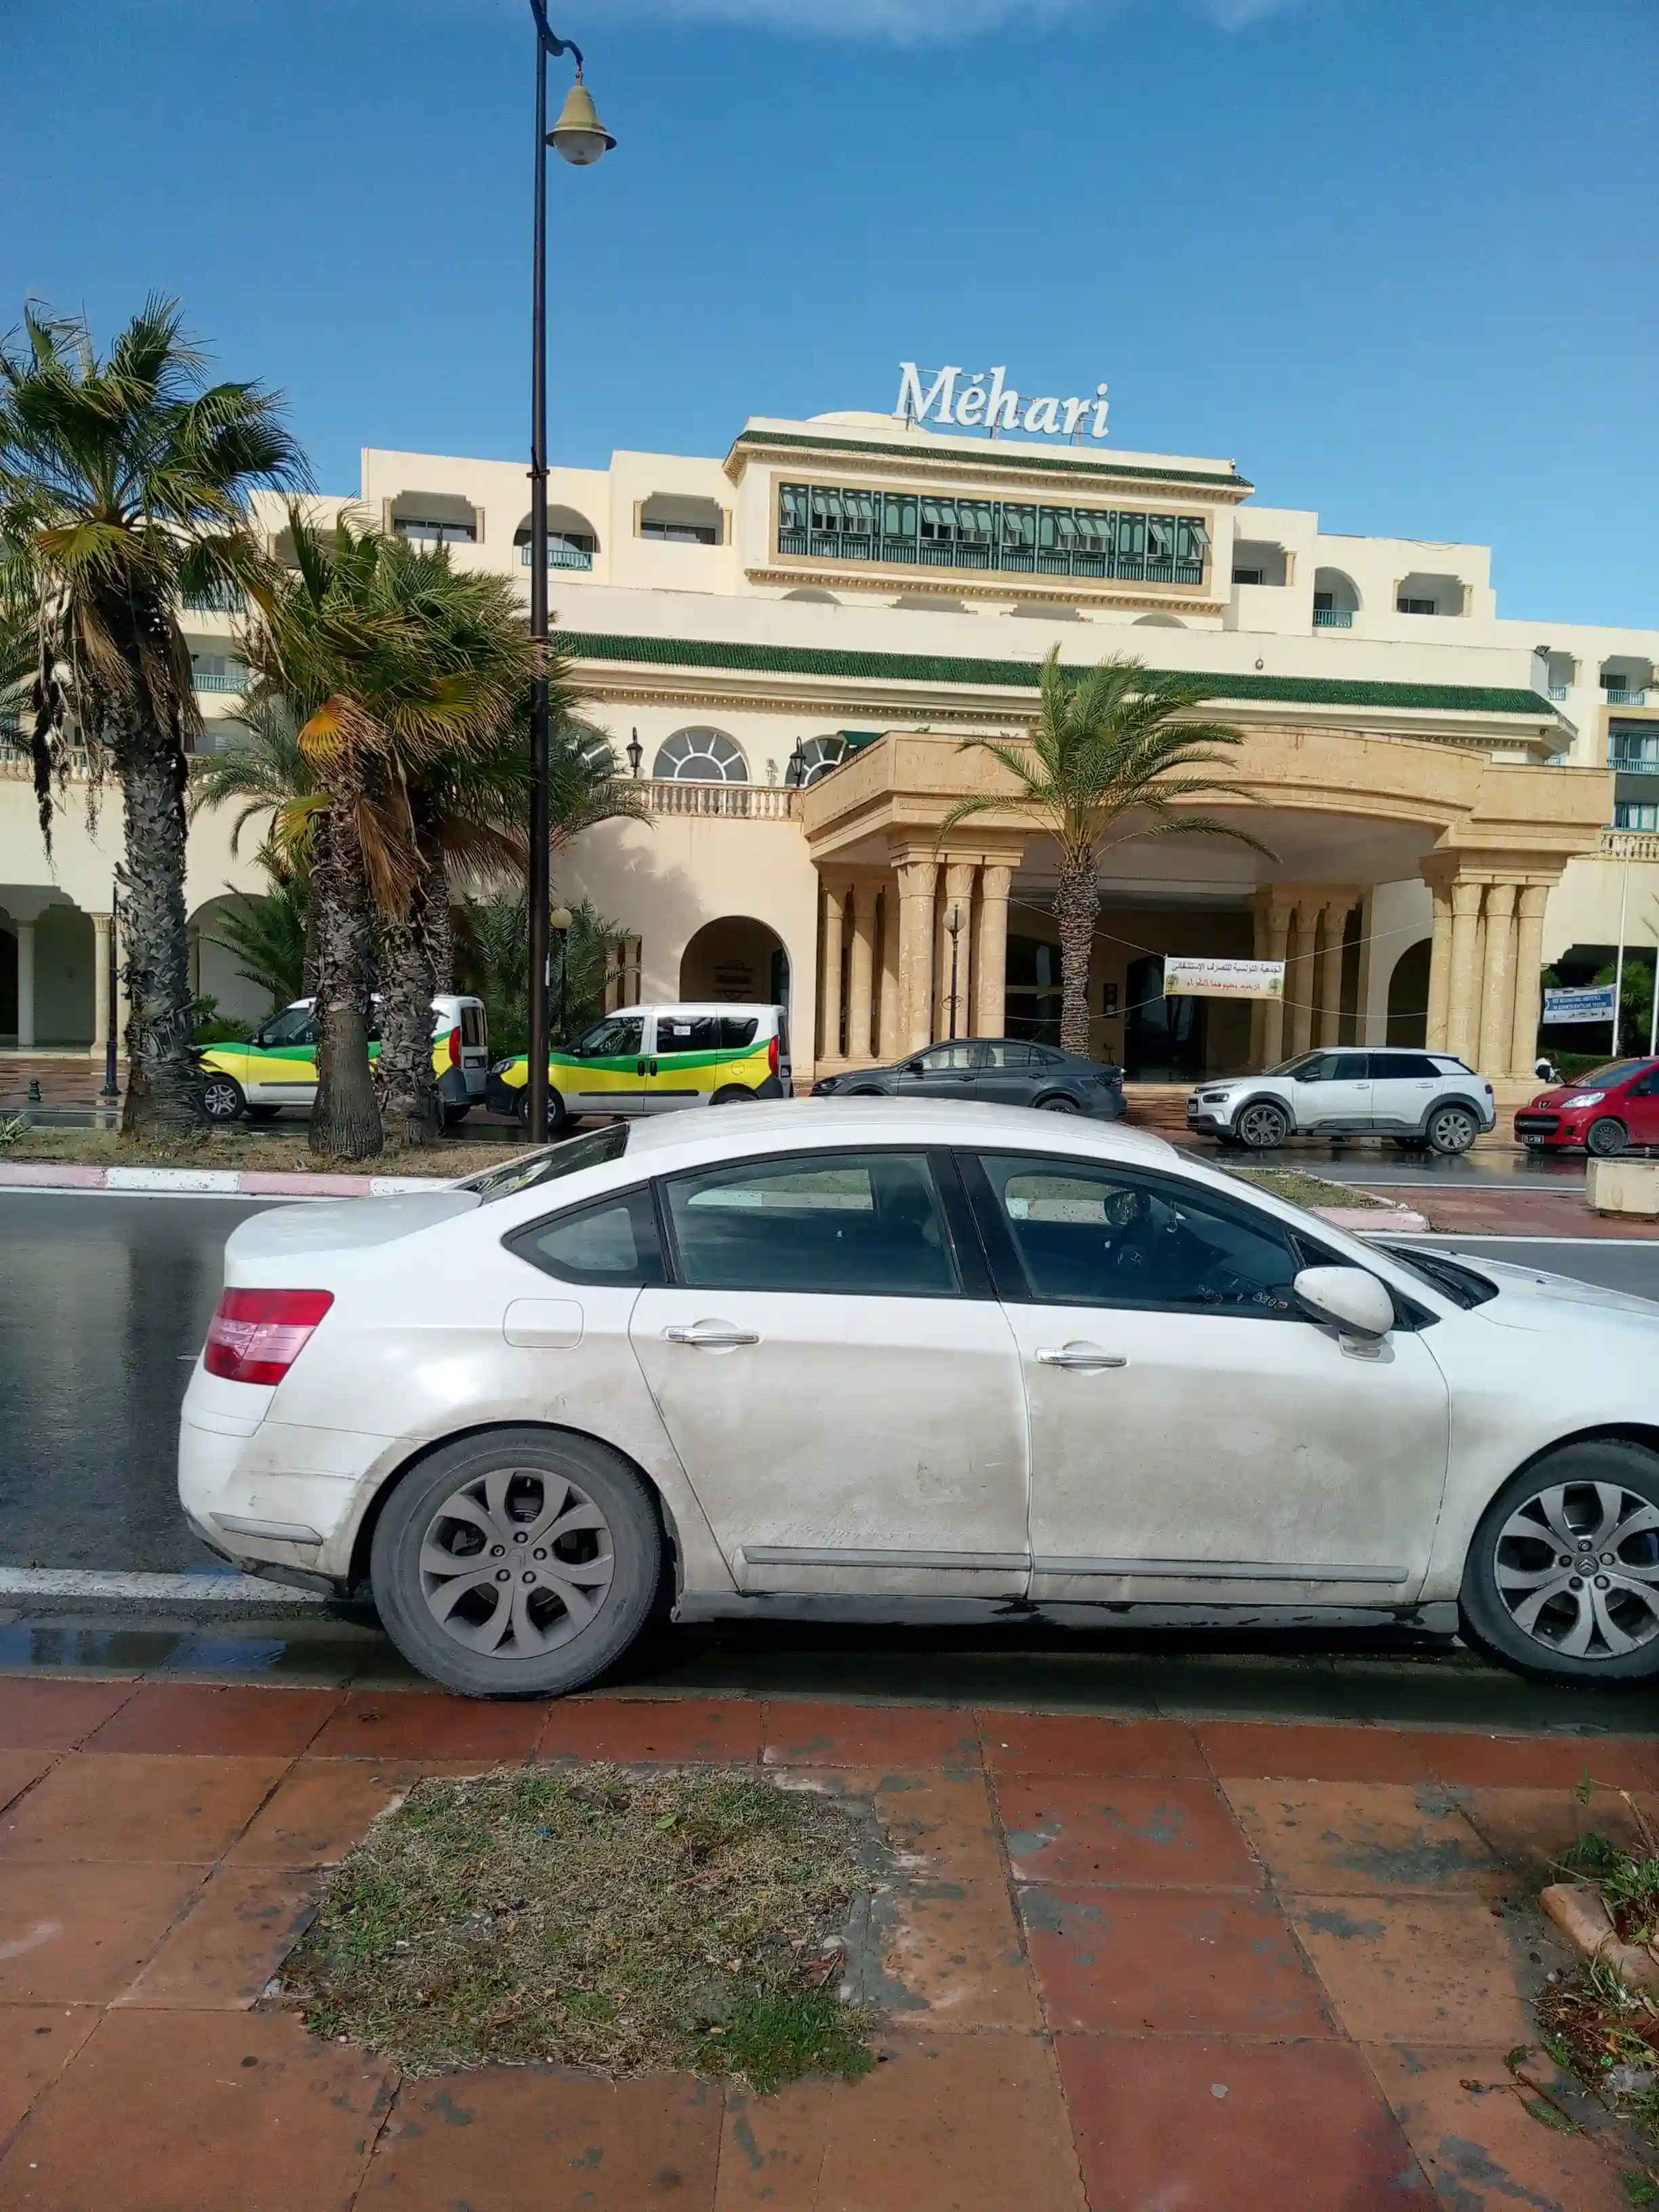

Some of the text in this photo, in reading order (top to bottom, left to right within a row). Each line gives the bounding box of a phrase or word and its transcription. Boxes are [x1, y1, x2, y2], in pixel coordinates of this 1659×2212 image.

[892, 361, 1109, 438] Méhari
[1207, 962, 1232, 973] للتصرف
[1233, 962, 1258, 974] التونسية
[1260, 963, 1282, 975] الجمعية
